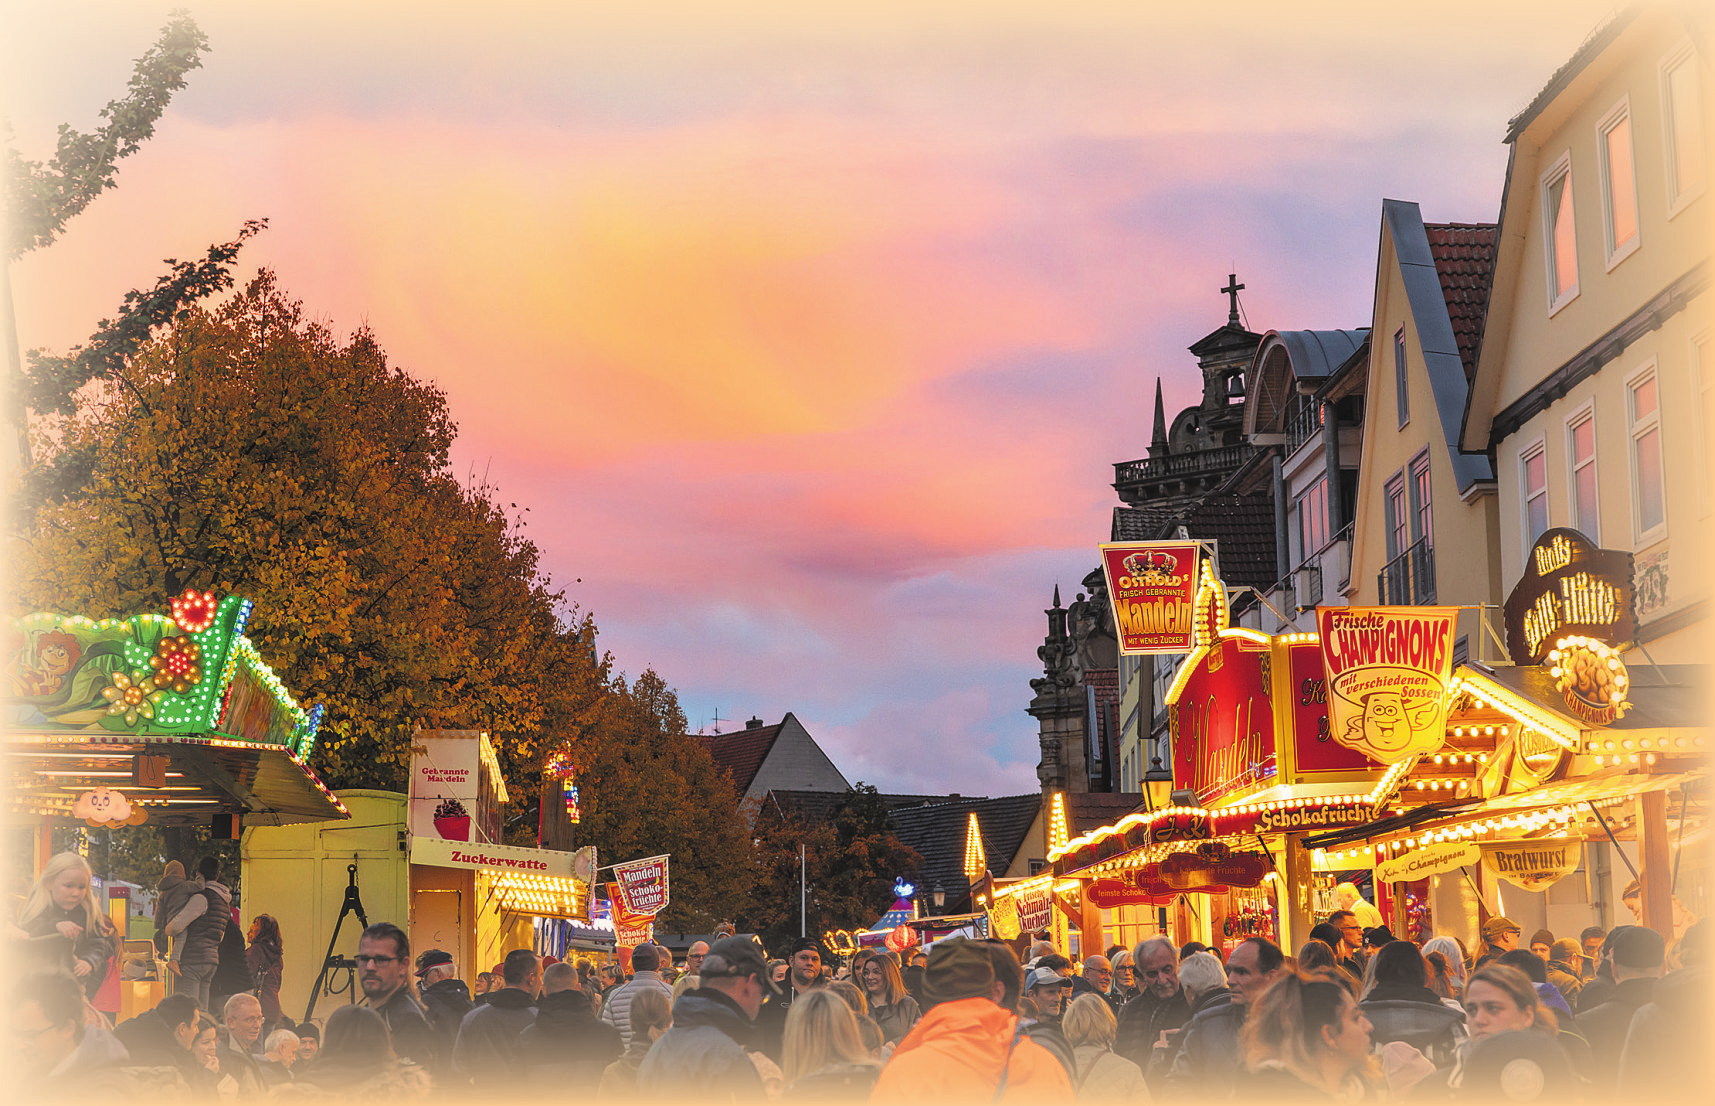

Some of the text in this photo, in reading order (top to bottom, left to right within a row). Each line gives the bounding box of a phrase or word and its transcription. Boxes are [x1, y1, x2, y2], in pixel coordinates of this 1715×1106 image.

[1115, 596, 1193, 636] Mandeln
[1331, 611, 1385, 629] Frische
[1322, 610, 1450, 675] CHAMPIGNONS
[1340, 673, 1358, 689] mit
[1345, 674, 1429, 695] verschiedenen
[1400, 685, 1441, 700] Sossen
[1565, 689, 1608, 724] CHAMPIGNONS
[421, 767, 470, 776] Gebrannte
[427, 775, 466, 783] Mandeln
[1255, 804, 1381, 834] Schokofrüchte
[451, 850, 548, 871] Zuckerwatte
[1408, 849, 1466, 872] Champignons
[1494, 847, 1566, 872] Bratwurst
[622, 866, 662, 883] Mandeln
[1217, 865, 1246, 875] Früchte
[632, 892, 663, 907] früchte
[1097, 888, 1121, 897] feinste
[1021, 911, 1051, 931] kuchen
